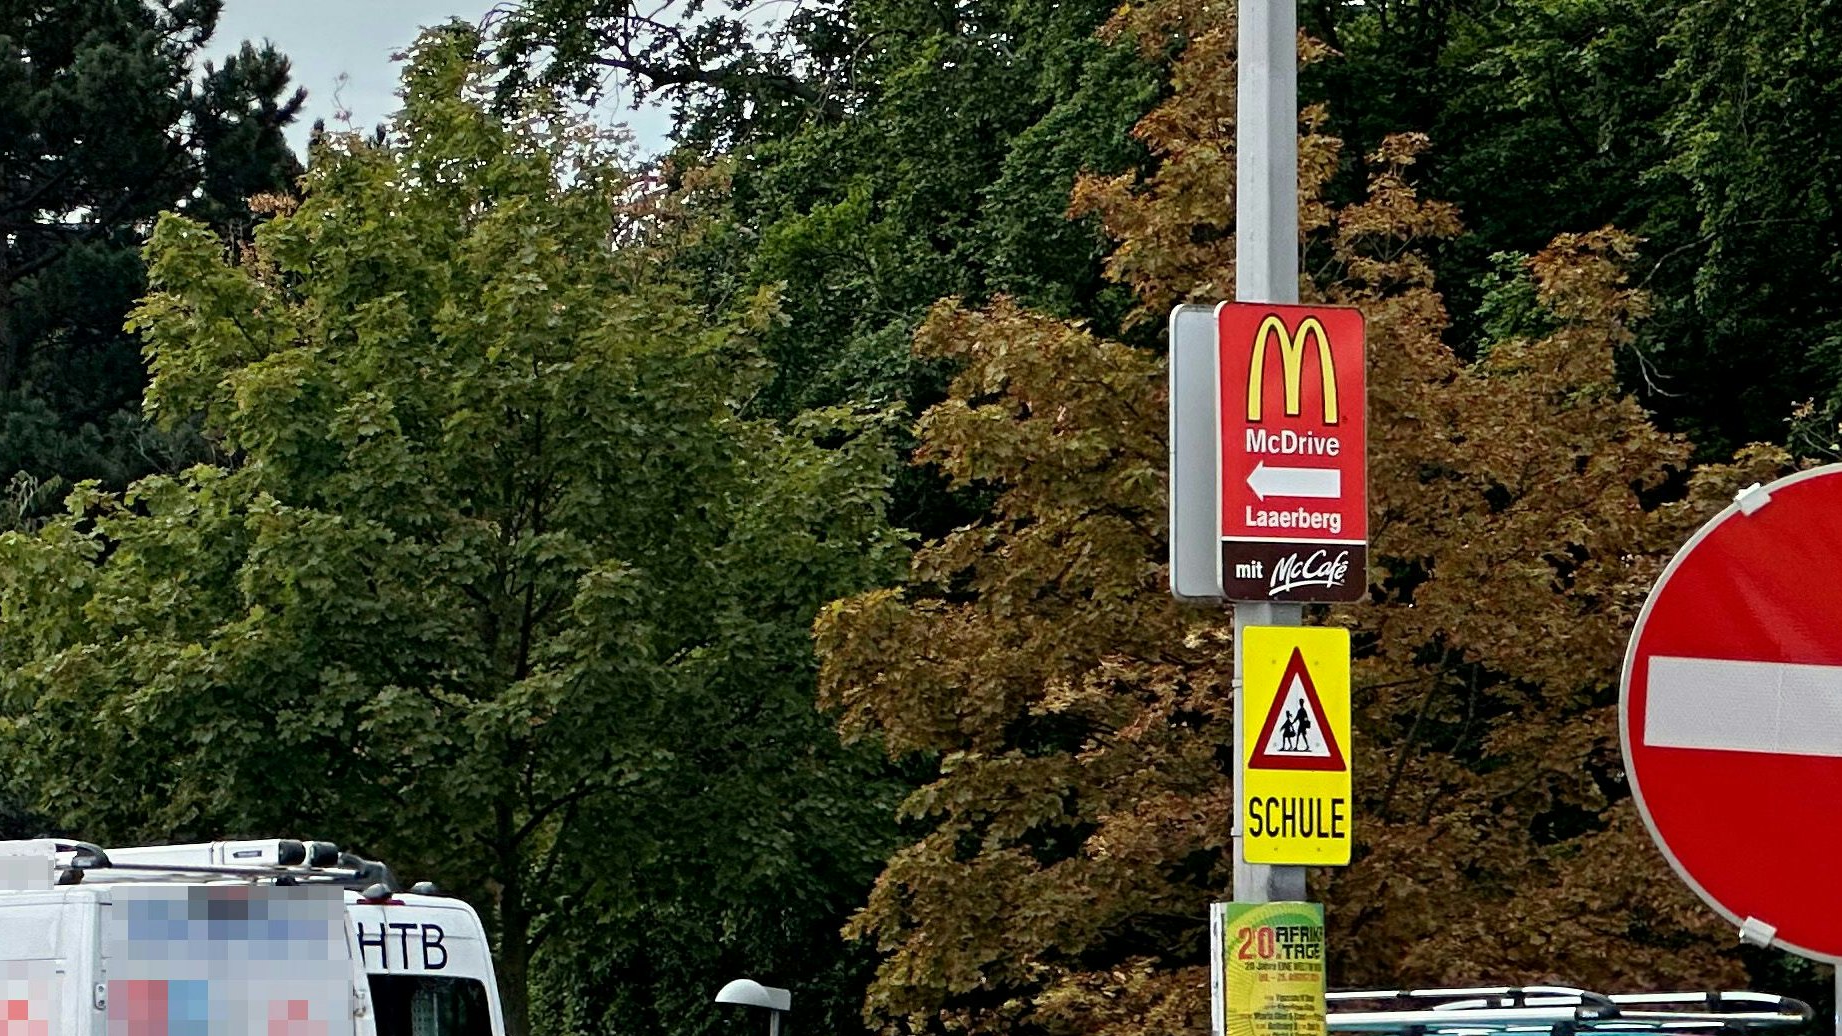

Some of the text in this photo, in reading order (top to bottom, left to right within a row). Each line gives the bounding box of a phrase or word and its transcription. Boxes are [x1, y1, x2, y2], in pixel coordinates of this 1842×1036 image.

[1246, 428, 1340, 457] McDrive
[1245, 505, 1342, 534] Laaerberg
[1235, 549, 1349, 593] mit McCafé
[1248, 796, 1345, 839] SCHULE
[357, 921, 448, 970] HTB
[1281, 943, 1321, 960] TAGE
